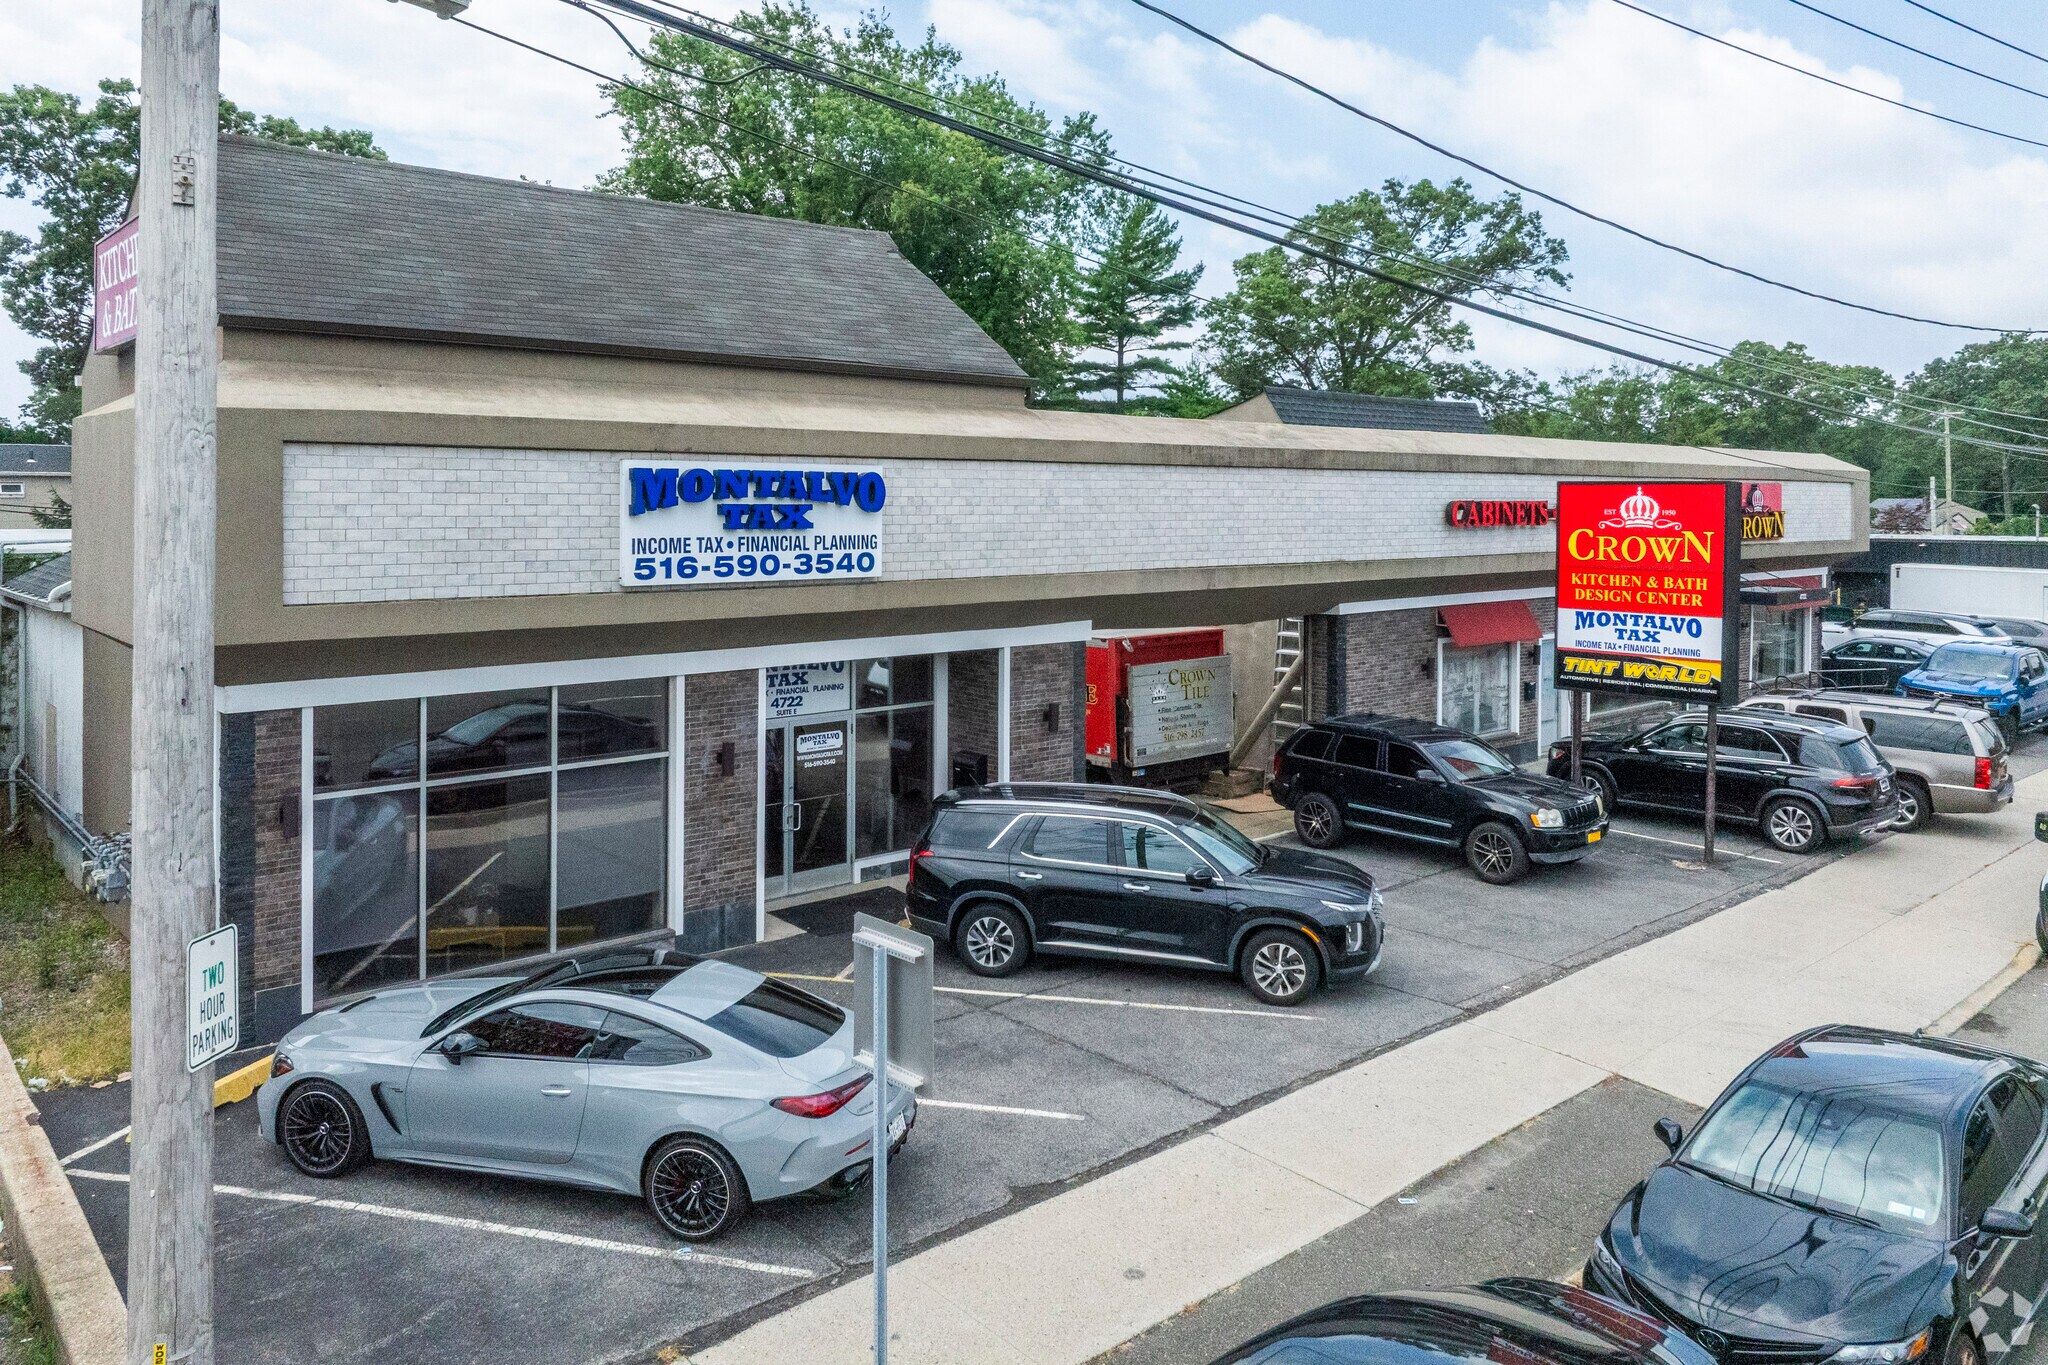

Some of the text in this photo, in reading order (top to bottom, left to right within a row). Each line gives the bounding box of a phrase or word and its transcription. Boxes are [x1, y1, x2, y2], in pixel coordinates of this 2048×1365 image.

[99, 232, 139, 291] KITCH
[102, 286, 138, 337] & BAT
[629, 467, 886, 516] MONTALVO
[717, 503, 814, 530] TAX
[1446, 500, 1549, 528] CABINETS
[1742, 511, 1786, 539] ROWN
[631, 534, 878, 555] INCOME TAX FINANCIAL PLANNING
[1568, 528, 1715, 564] CROWN
[633, 552, 876, 580] 516-590-3540
[1571, 573, 1708, 591] KITCHEN & BATH
[1575, 588, 1703, 606] DESIGN CENTER
[1575, 611, 1702, 639] MONTALVO
[1615, 628, 1661, 643] TAX
[1575, 640, 1701, 657] INCOME TAX FINANCIAL PLANNING
[766, 671, 808, 687] TAX
[1168, 668, 1216, 686] CROWN
[1560, 675, 1599, 683] AUTOMOTIVE
[1603, 679, 1643, 687] RESIDENTIAL
[1645, 683, 1688, 692] COMMERCIAL
[1563, 657, 1712, 685] TINT WORLD
[771, 696, 803, 708] 4722
[776, 687, 809, 696] FINANCIAL
[813, 683, 844, 692] PLANNING
[1181, 683, 1210, 700] TILE
[800, 732, 840, 745] MONTALVO
[202, 961, 225, 992] TWO
[200, 992, 225, 1024] HOUR
[193, 1016, 233, 1058] PARKING
